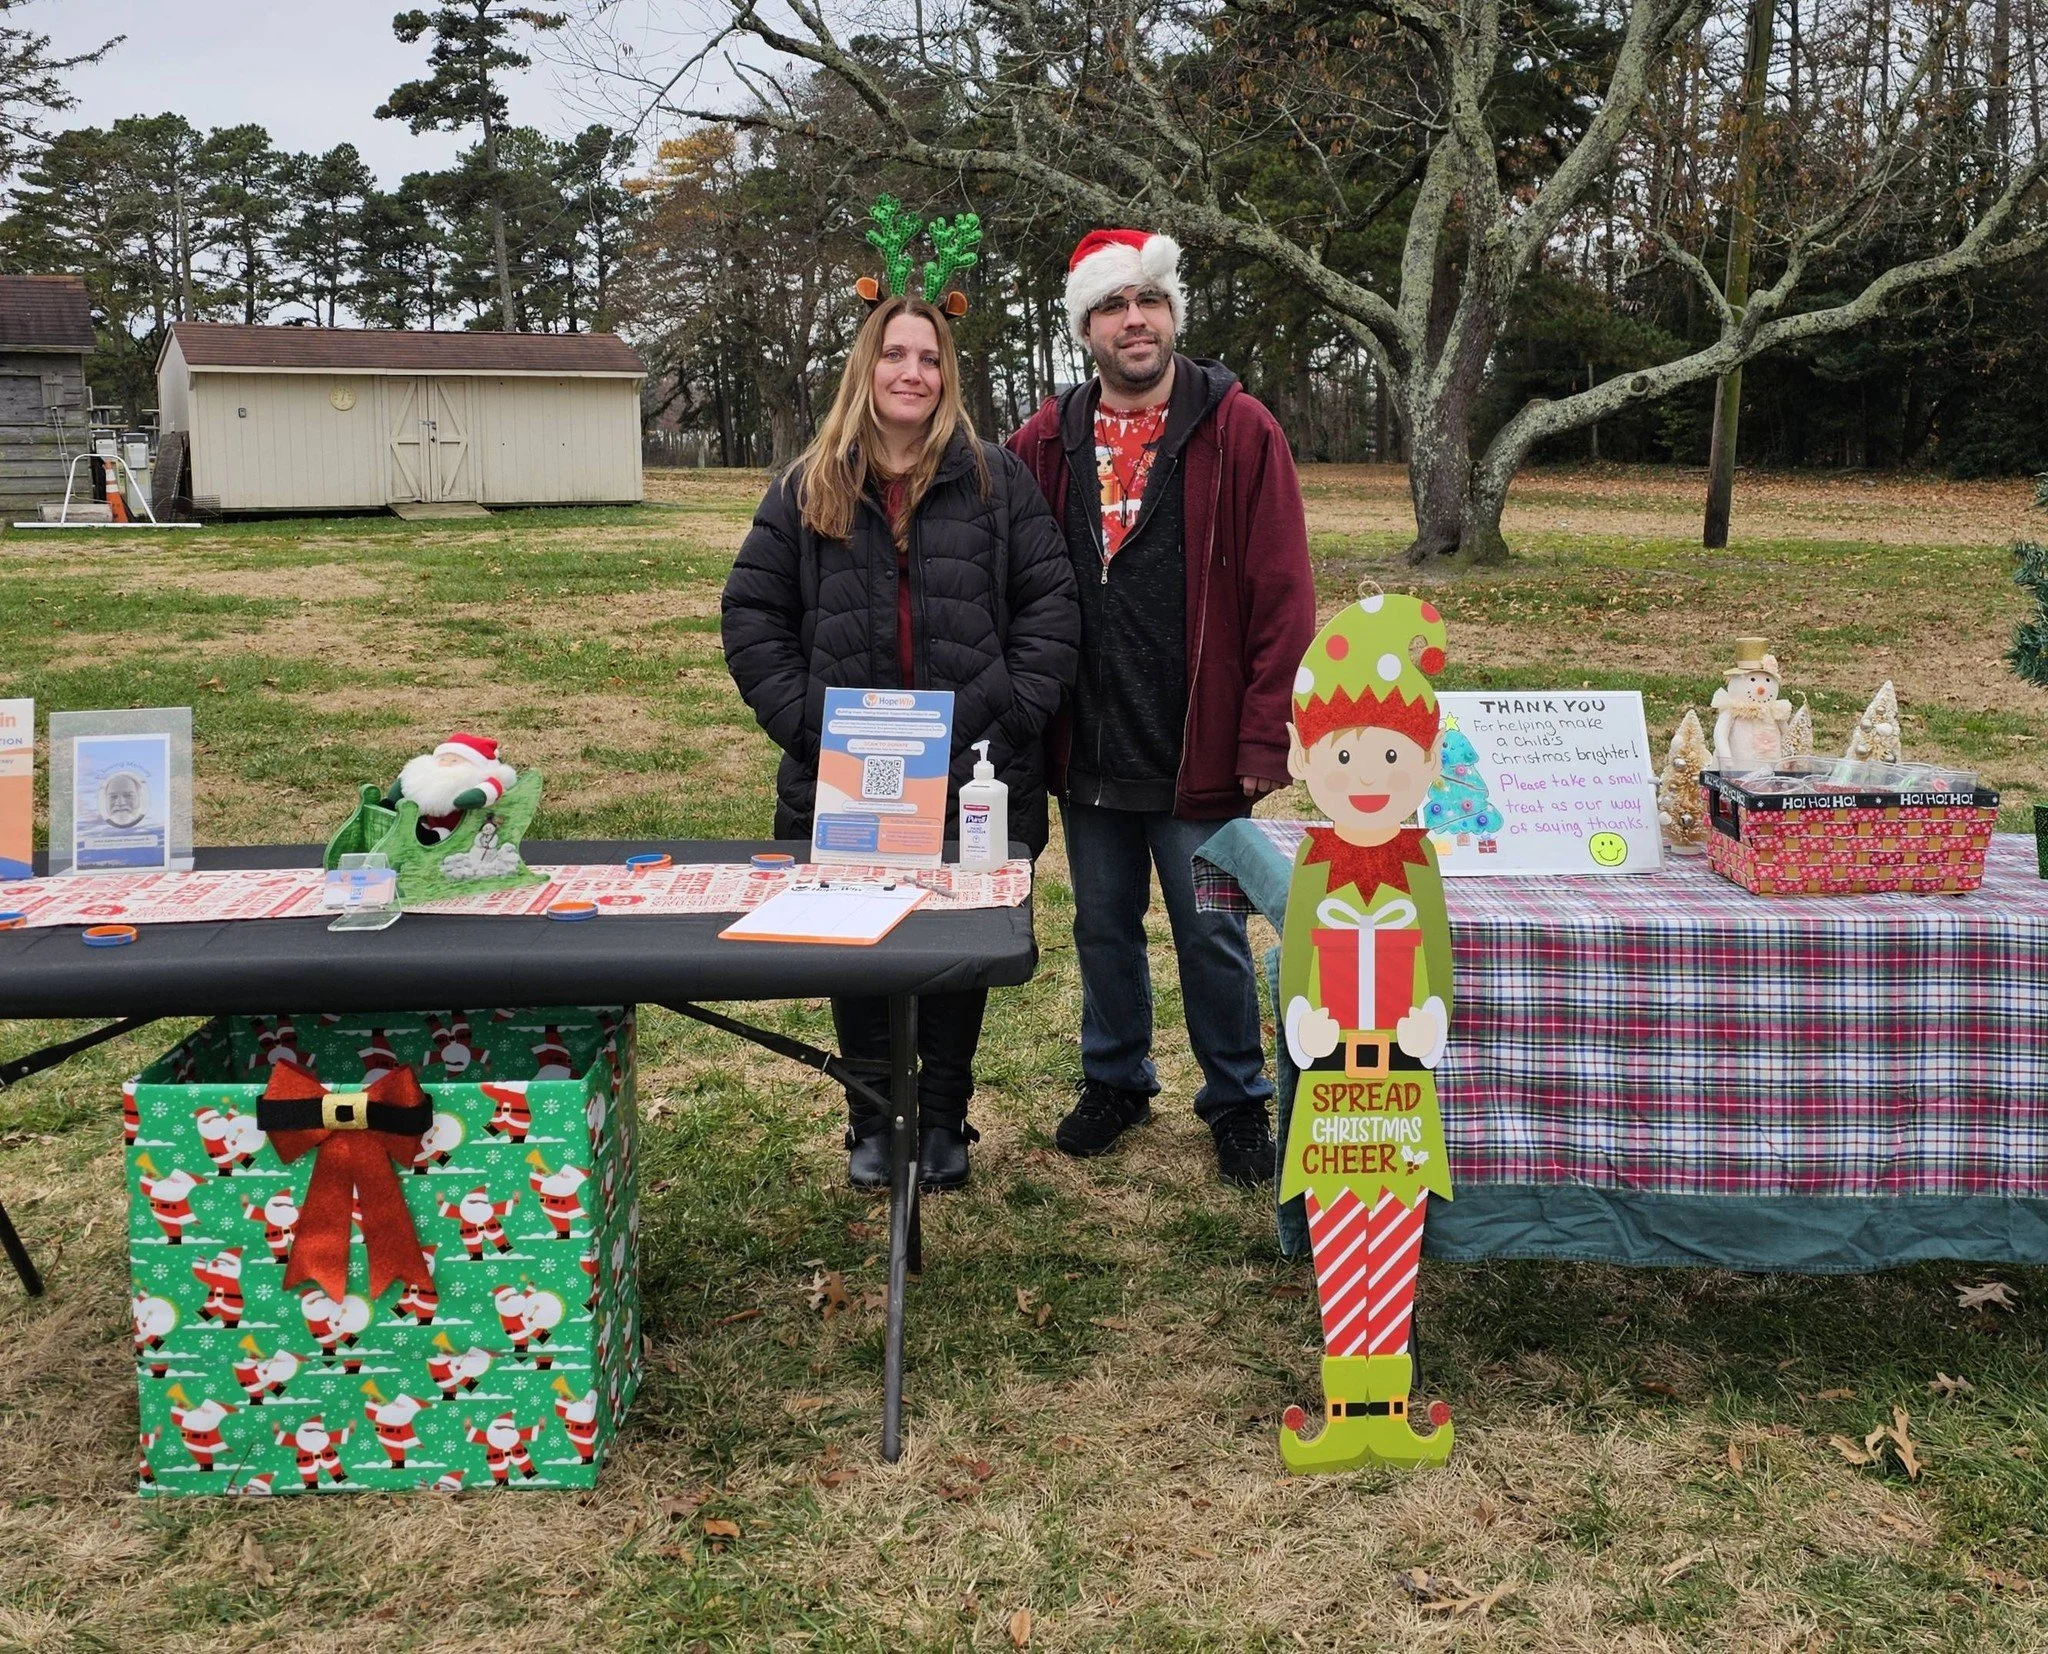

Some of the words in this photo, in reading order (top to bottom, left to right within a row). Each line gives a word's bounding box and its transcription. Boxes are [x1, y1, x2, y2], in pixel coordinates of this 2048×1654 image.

[1479, 699, 1558, 714] THANK
[1564, 699, 1606, 713] YOU
[1473, 719, 1494, 732] For
[1499, 717, 1557, 736] helping
[1559, 717, 1604, 730] make
[1496, 737, 1507, 746] a
[1491, 750, 1572, 765] Christmas
[1575, 740, 1639, 765] brighter!
[1499, 773, 1547, 792] Please
[1551, 773, 1586, 789] take
[1592, 775, 1603, 785] a
[1608, 772, 1642, 786] small
[1505, 799, 1545, 813] treat
[1551, 801, 1568, 812] as
[1574, 800, 1602, 811] our
[1611, 797, 1641, 813] way
[1782, 797, 1806, 809] HO!
[1808, 796, 1831, 809] HO!
[1832, 795, 1857, 807] HO!
[1900, 793, 1924, 805] HO!
[1925, 793, 1948, 805] HO!
[1949, 793, 1974, 805] HO!
[1510, 822, 1527, 835] of
[1535, 820, 1583, 838] saying
[1587, 816, 1649, 831] thanks.
[1312, 1082, 1422, 1113] SPREAD
[1312, 1115, 1422, 1144] CHRISTMAS
[1302, 1143, 1398, 1175] CHEER
